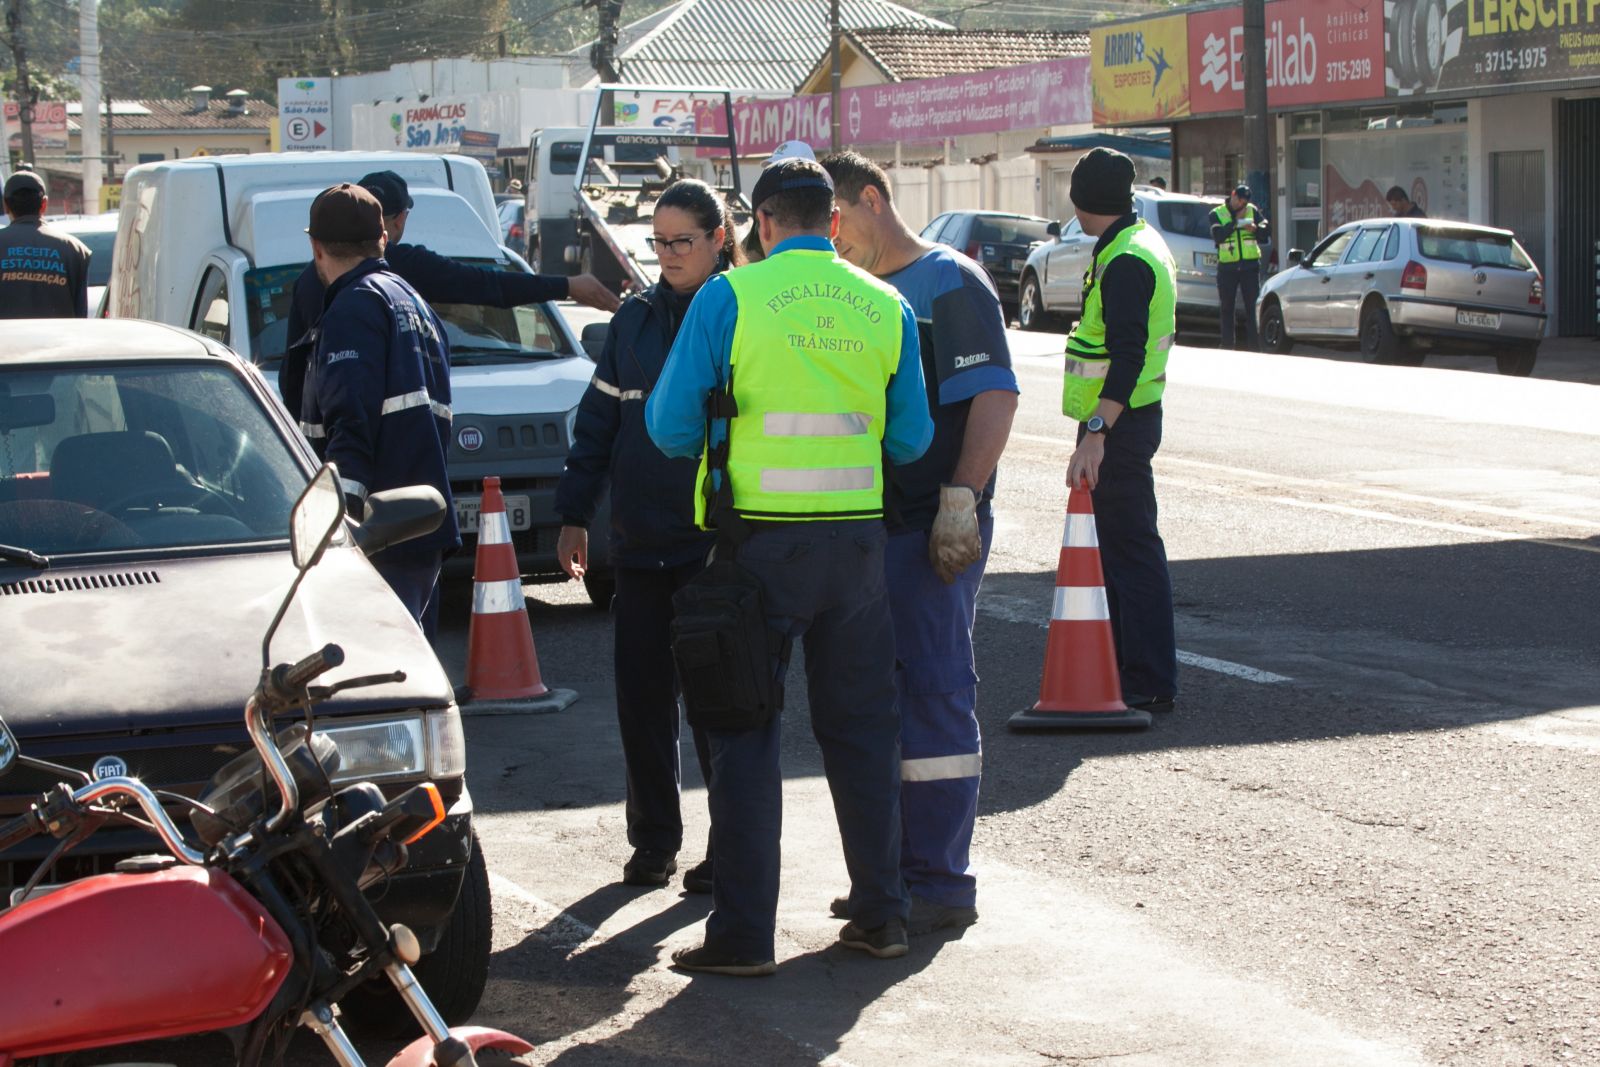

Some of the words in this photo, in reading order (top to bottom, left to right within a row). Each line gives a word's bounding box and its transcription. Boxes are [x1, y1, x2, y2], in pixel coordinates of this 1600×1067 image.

[1327, 11, 1369, 27] Análises
[1327, 29, 1369, 43] Clínicas
[1230, 17, 1316, 91] Ezilab
[1485, 47, 1547, 73] 3715-1975
[1327, 58, 1371, 82] 3715-2919
[994, 73, 1025, 94] Tecidos
[1114, 70, 1151, 88] ESPORTES
[406, 103, 466, 123] FARMÁCIAS
[732, 97, 830, 145] TAMPING
[293, 123, 303, 136] E
[406, 123, 431, 147] São
[8, 246, 60, 258] RECEITA
[1, 259, 65, 273] ESTADUAL
[2, 272, 67, 285] FISCALIZAÇÃO
[767, 283, 881, 324] FISCALIZAÇÃO
[816, 316, 834, 328] DE
[788, 333, 863, 353] TRÂNSITO
[954, 352, 986, 368] Detran
[463, 432, 478, 446] FIAT
[99, 764, 121, 776] FIAT
